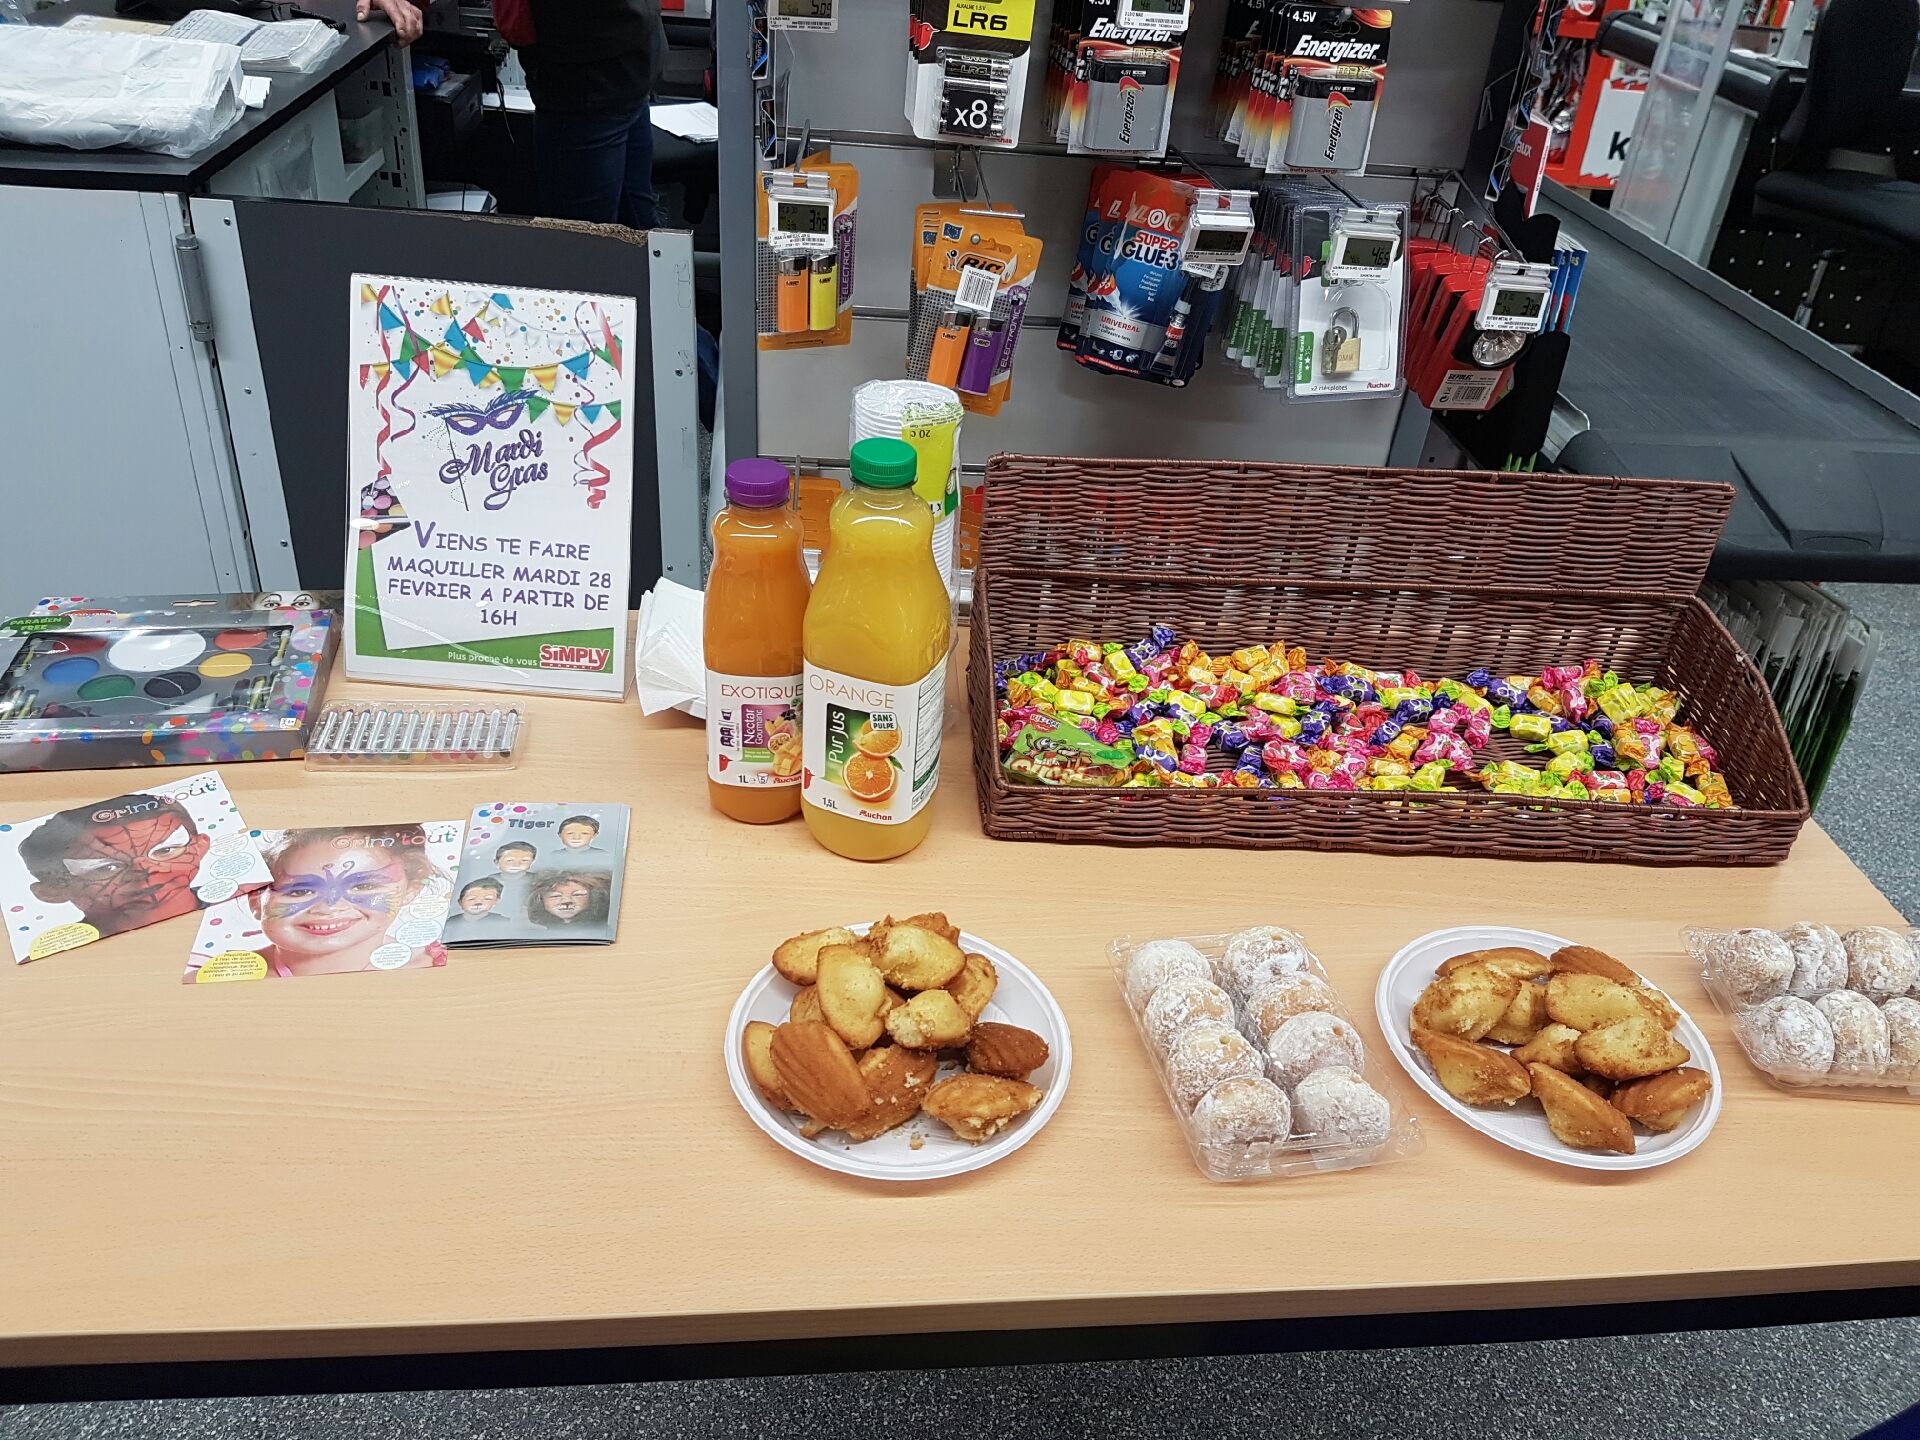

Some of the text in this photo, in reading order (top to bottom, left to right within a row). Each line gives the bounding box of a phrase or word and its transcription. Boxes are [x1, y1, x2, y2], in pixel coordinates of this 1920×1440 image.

[953, 10, 1008, 31] LR6
[1292, 11, 1317, 23] 4.5V
[1292, 34, 1381, 62] Energizer
[961, 65, 987, 76] LR6
[953, 99, 988, 129] x8
[1119, 91, 1136, 144] Energizer
[1324, 107, 1344, 161] Energizer
[1132, 231, 1179, 251] SUPER
[842, 235, 851, 296] ELECTRONIC
[1121, 240, 1180, 271] GLUE-3
[1101, 315, 1140, 333] UNIVERSAL
[1000, 308, 1021, 368] ELECTRONIC
[919, 429, 931, 438] 20
[439, 429, 544, 484] Mardi
[484, 461, 549, 511] Gras
[414, 520, 591, 561] VIENS TE FAIRE
[387, 556, 611, 589] MAQUILLER MARDI 28
[388, 578, 609, 611] FEVRIER A PARTIR DE
[9, 617, 62, 627] PARABEN
[480, 608, 517, 626] 16H
[20, 624, 48, 632] FREE
[448, 651, 467, 661] Plus
[502, 656, 514, 666] de
[516, 658, 538, 667] vous
[721, 684, 803, 700] EXOTIQUE
[809, 674, 896, 709] ORANGE
[743, 709, 756, 744] Nectar
[872, 713, 893, 723] SANS
[873, 721, 895, 730] PULPE
[829, 735, 845, 764] Pur
[738, 775, 749, 784] 1L
[508, 818, 556, 830] Tiger
[859, 809, 892, 821] Auchan
[331, 831, 456, 850] Grim'tout
